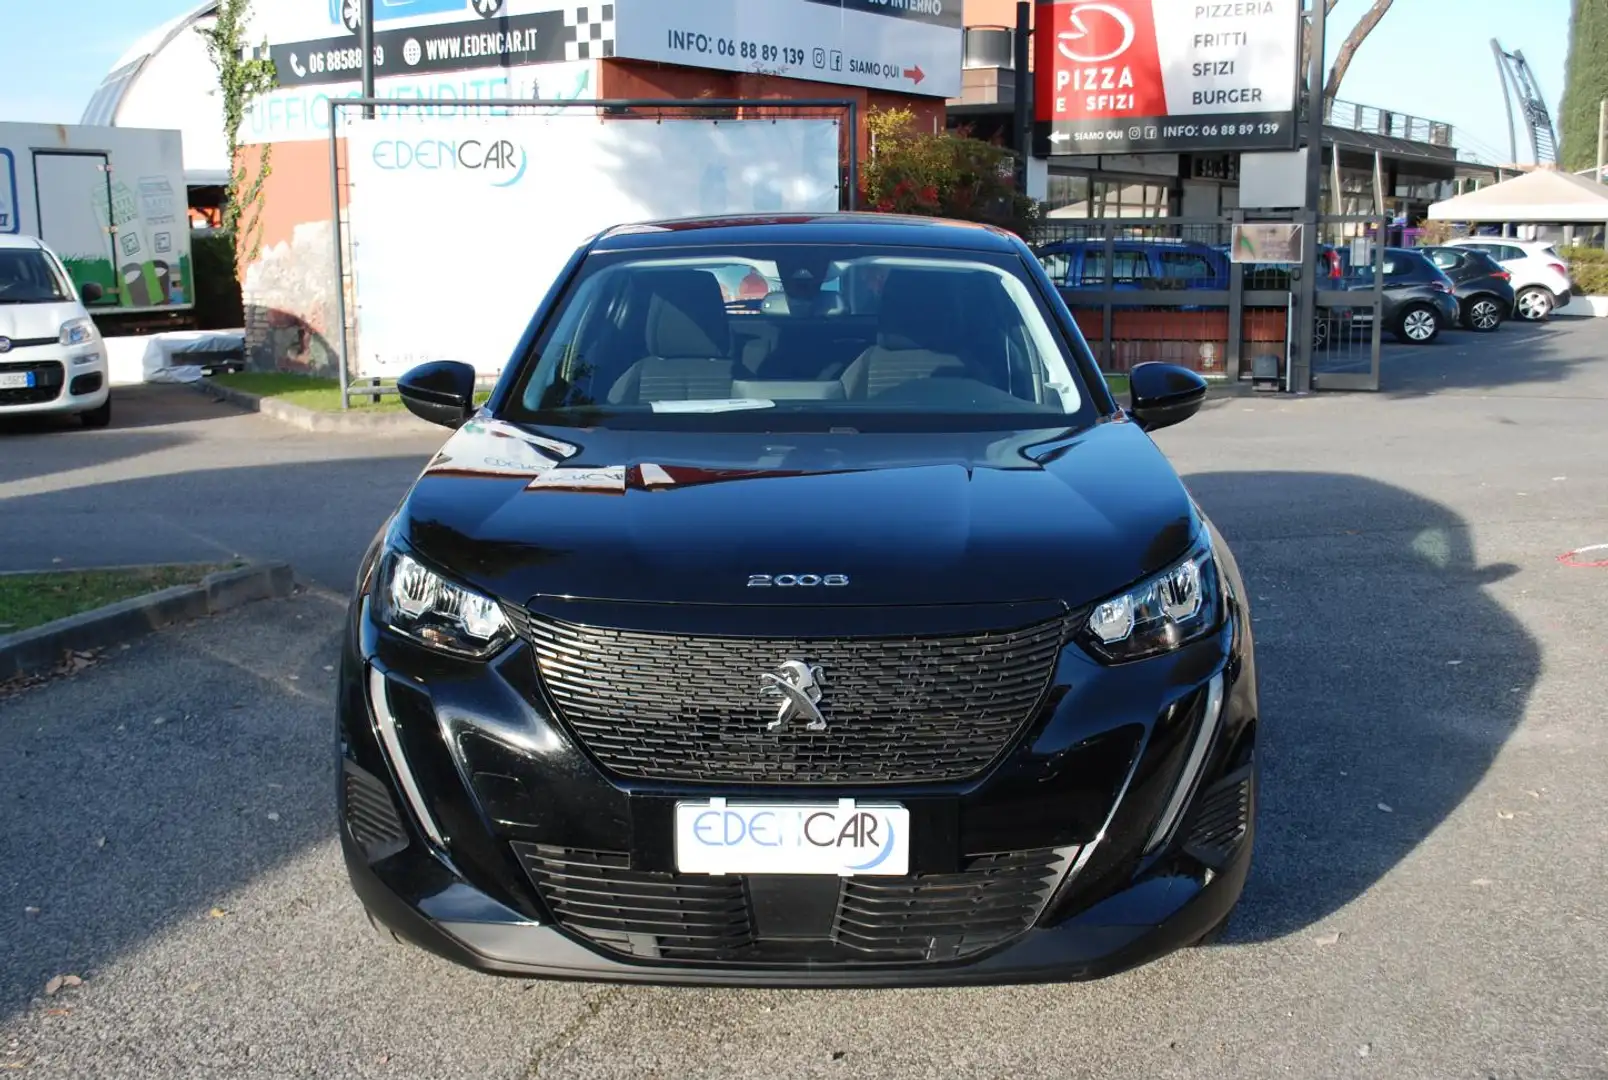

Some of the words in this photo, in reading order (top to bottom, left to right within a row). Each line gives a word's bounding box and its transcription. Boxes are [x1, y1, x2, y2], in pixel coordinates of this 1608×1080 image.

[1195, 1, 1274, 19] PIZZERIA
[425, 28, 538, 60] WWW.EDENCAR.IT
[668, 29, 712, 54] INFO:
[717, 38, 735, 56] 06
[740, 41, 757, 59] 88
[761, 44, 778, 61] 89
[782, 47, 804, 65] 139
[1194, 32, 1247, 48] FRITTI
[309, 52, 325, 73] 06
[849, 59, 881, 76] SIAMO
[882, 64, 900, 78] QUI
[1192, 60, 1234, 77] SFIZI
[1057, 67, 1134, 92] PIZZA
[1056, 97, 1067, 112] E
[1086, 94, 1134, 111] SFIZI
[1193, 88, 1262, 105] BURGER
[250, 88, 363, 134] UFFICI
[1074, 132, 1104, 141] SIAMO
[1106, 130, 1123, 141] QUI
[1163, 126, 1199, 138] INFO:
[1202, 125, 1217, 136] 06
[1221, 125, 1236, 135] 88
[1239, 124, 1254, 135] 89
[1257, 123, 1279, 135] 139
[373, 140, 516, 169] EDENCAR
[747, 574, 849, 586] 2008
